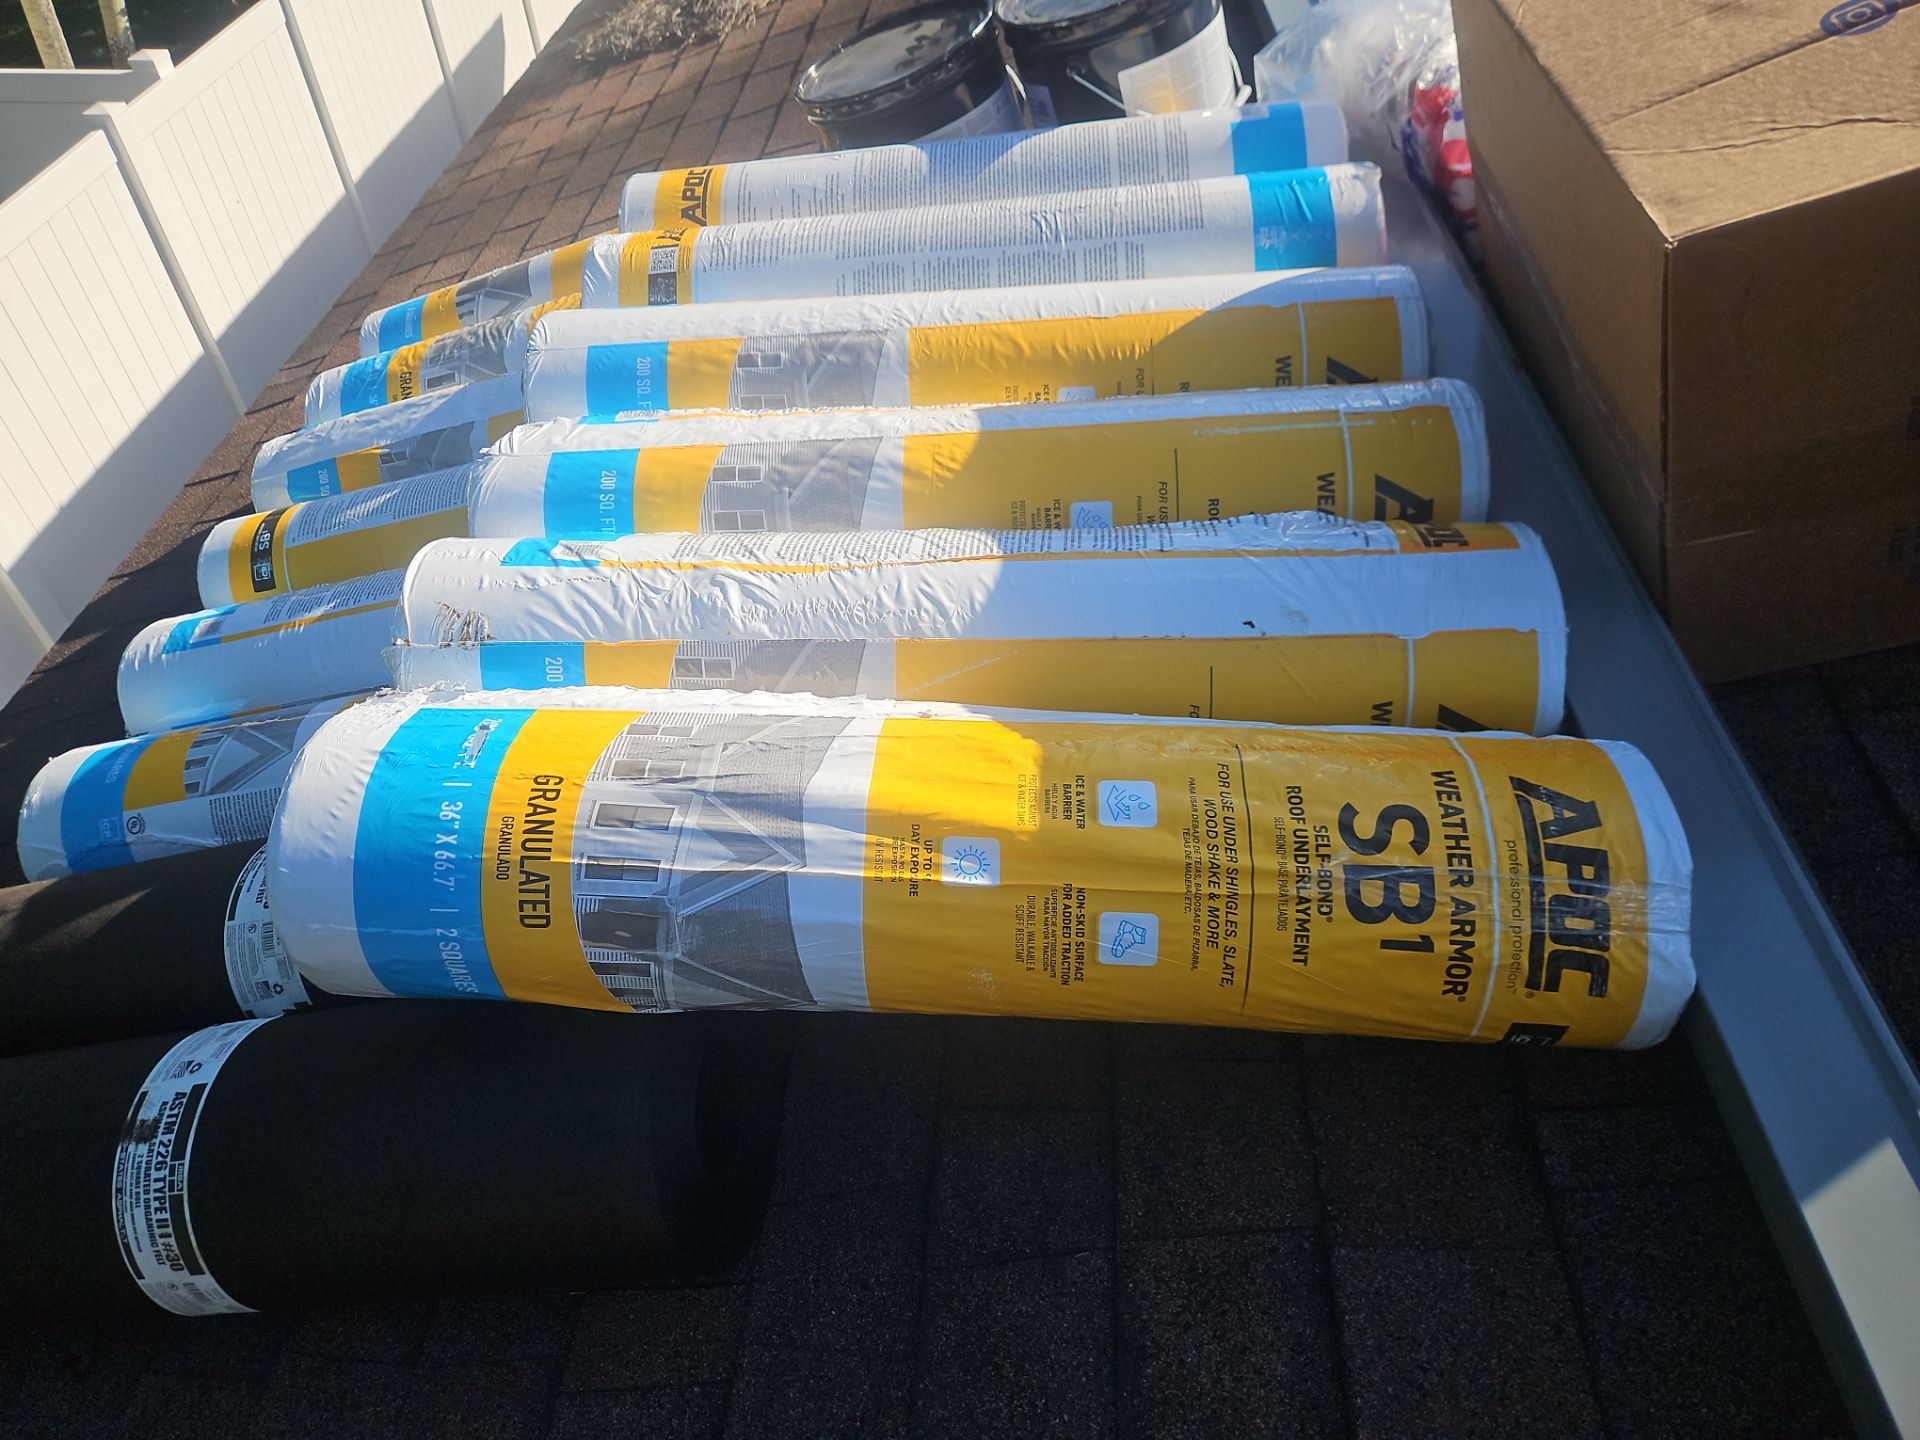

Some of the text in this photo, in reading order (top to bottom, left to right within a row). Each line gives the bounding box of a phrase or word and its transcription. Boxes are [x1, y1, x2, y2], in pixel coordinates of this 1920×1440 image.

[637, 357, 651, 376] 200
[600, 470, 616, 490] 200
[545, 656, 563, 683] 200
[1075, 774, 1086, 830] ICE & WATER
[1188, 776, 1196, 794] PARA
[1062, 784, 1072, 821] BARRIER
[1190, 795, 1198, 812] USAR
[911, 824, 920, 844] DAY
[1182, 827, 1190, 848] TEJAS
[1192, 813, 1200, 843] DEBAJO
[1430, 770, 1475, 889] WEATHER
[496, 816, 515, 881] GRANULADO
[518, 774, 565, 930] GRANULATED
[922, 856, 932, 870] TO
[923, 839, 933, 854] UP
[1184, 850, 1192, 860] DE
[1194, 845, 1200, 856] DE
[1203, 798, 1221, 950] WOOD SHAKE & MORE
[1217, 762, 1240, 988] FOR USE UNDER SHINGLES, SLATE,
[1277, 861, 1288, 878] BASE
[1286, 785, 1312, 967] ROOF UNDERLAYMENT
[1193, 882, 1202, 924] BALDOSAS
[1278, 879, 1288, 898] PARA
[1026, 895, 1036, 928] DURABLE,
[1277, 898, 1289, 932] TEJADOS
[1015, 904, 1024, 964] SCUFF RESISTANT
[1026, 930, 1036, 965] WALKABLE
[1060, 883, 1073, 986] FOR ADDED TRACTION
[1074, 888, 1086, 982] NON-SKID SURFACE
[1193, 926, 1200, 936] DE
[436, 928, 480, 994] 2 SQUARES
[161, 1092, 188, 1136] ASTM
[154, 1138, 172, 1172] 226
[143, 1142, 157, 1196] SATURATED
[153, 1249, 167, 1266] FELT
[153, 1174, 168, 1216] TYPE
